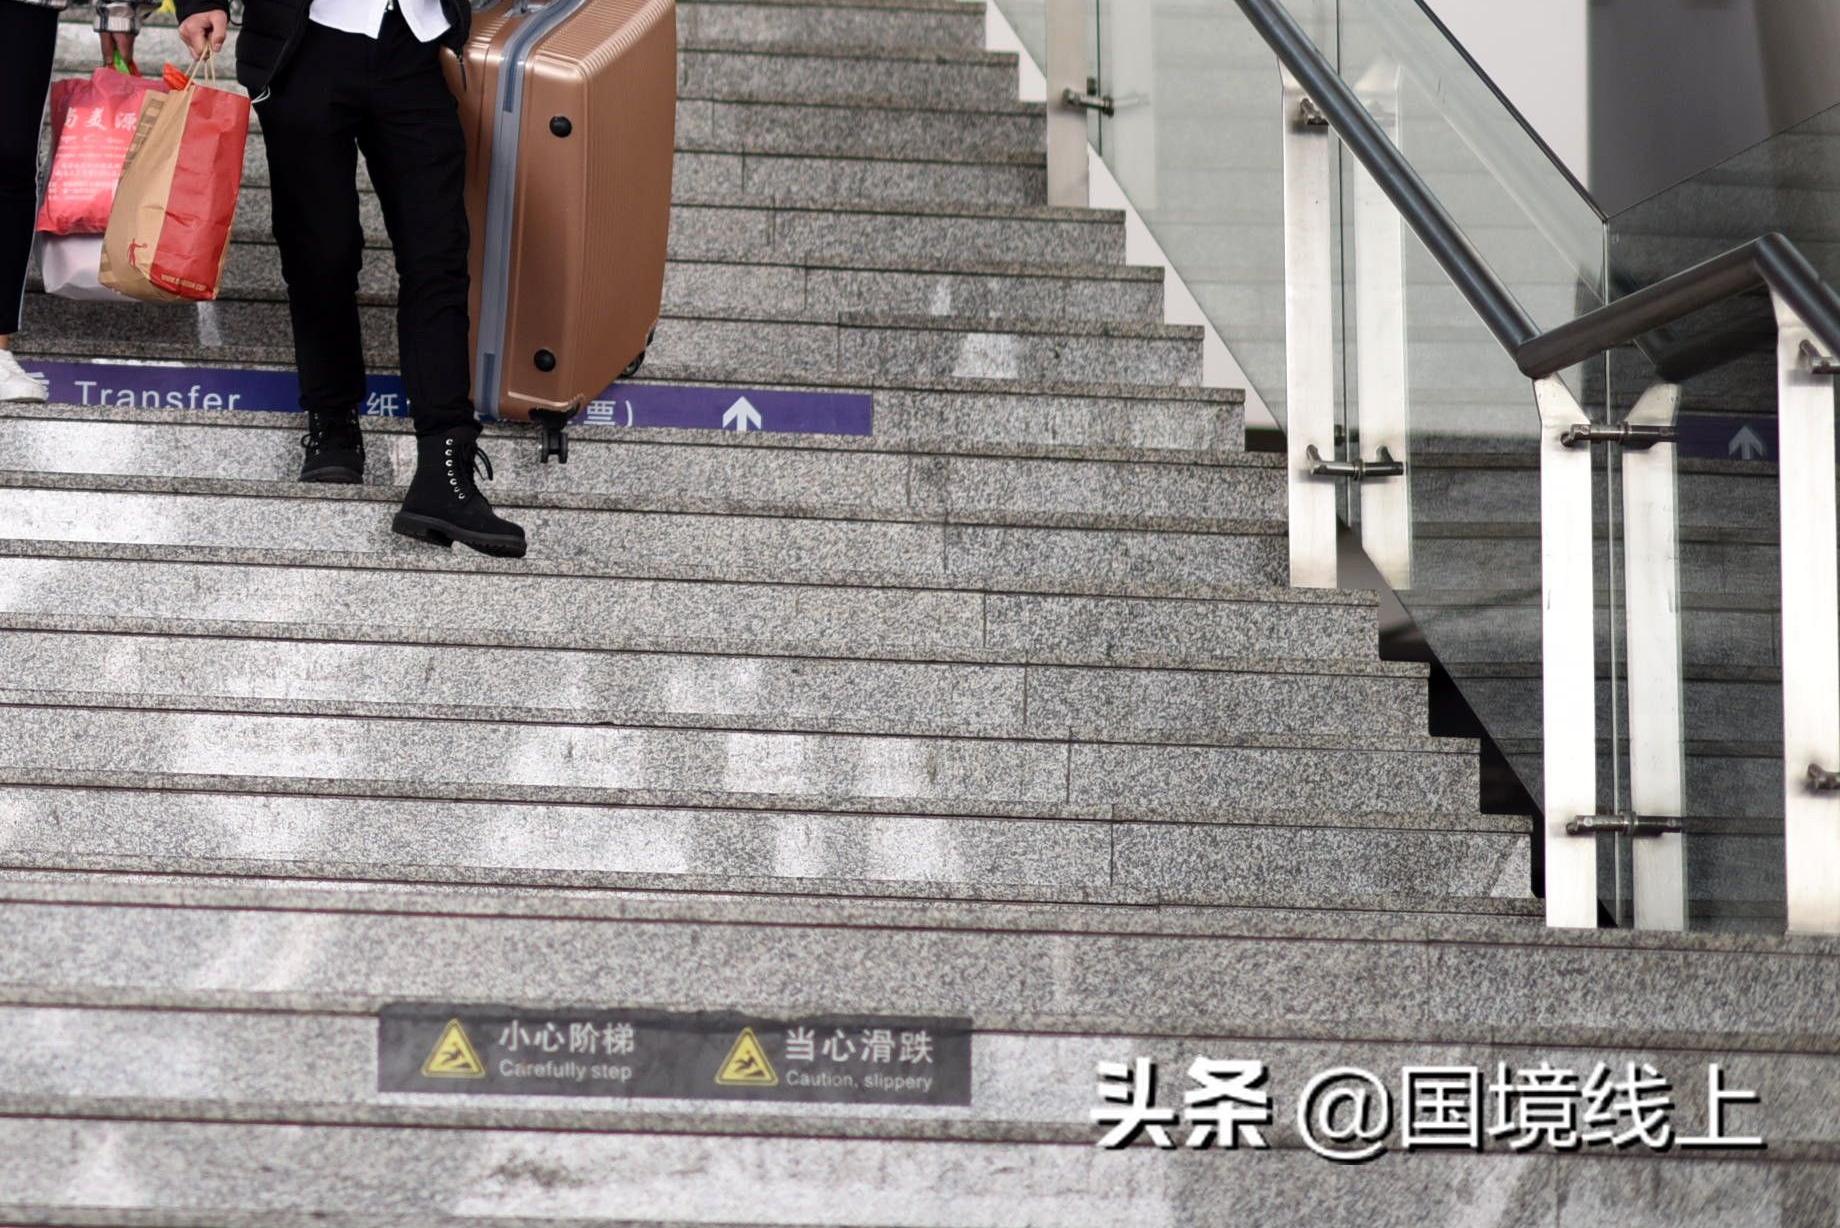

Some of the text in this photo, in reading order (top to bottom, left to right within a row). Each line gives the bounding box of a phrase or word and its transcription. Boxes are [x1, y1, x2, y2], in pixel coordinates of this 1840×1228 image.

[73, 380, 241, 411] Transfer
[498, 1020, 635, 1055] 小心阶梯
[785, 1026, 933, 1063] 当心滑跌
[498, 1058, 633, 1084] Carefully step
[785, 1069, 933, 1093] Caution, slippery
